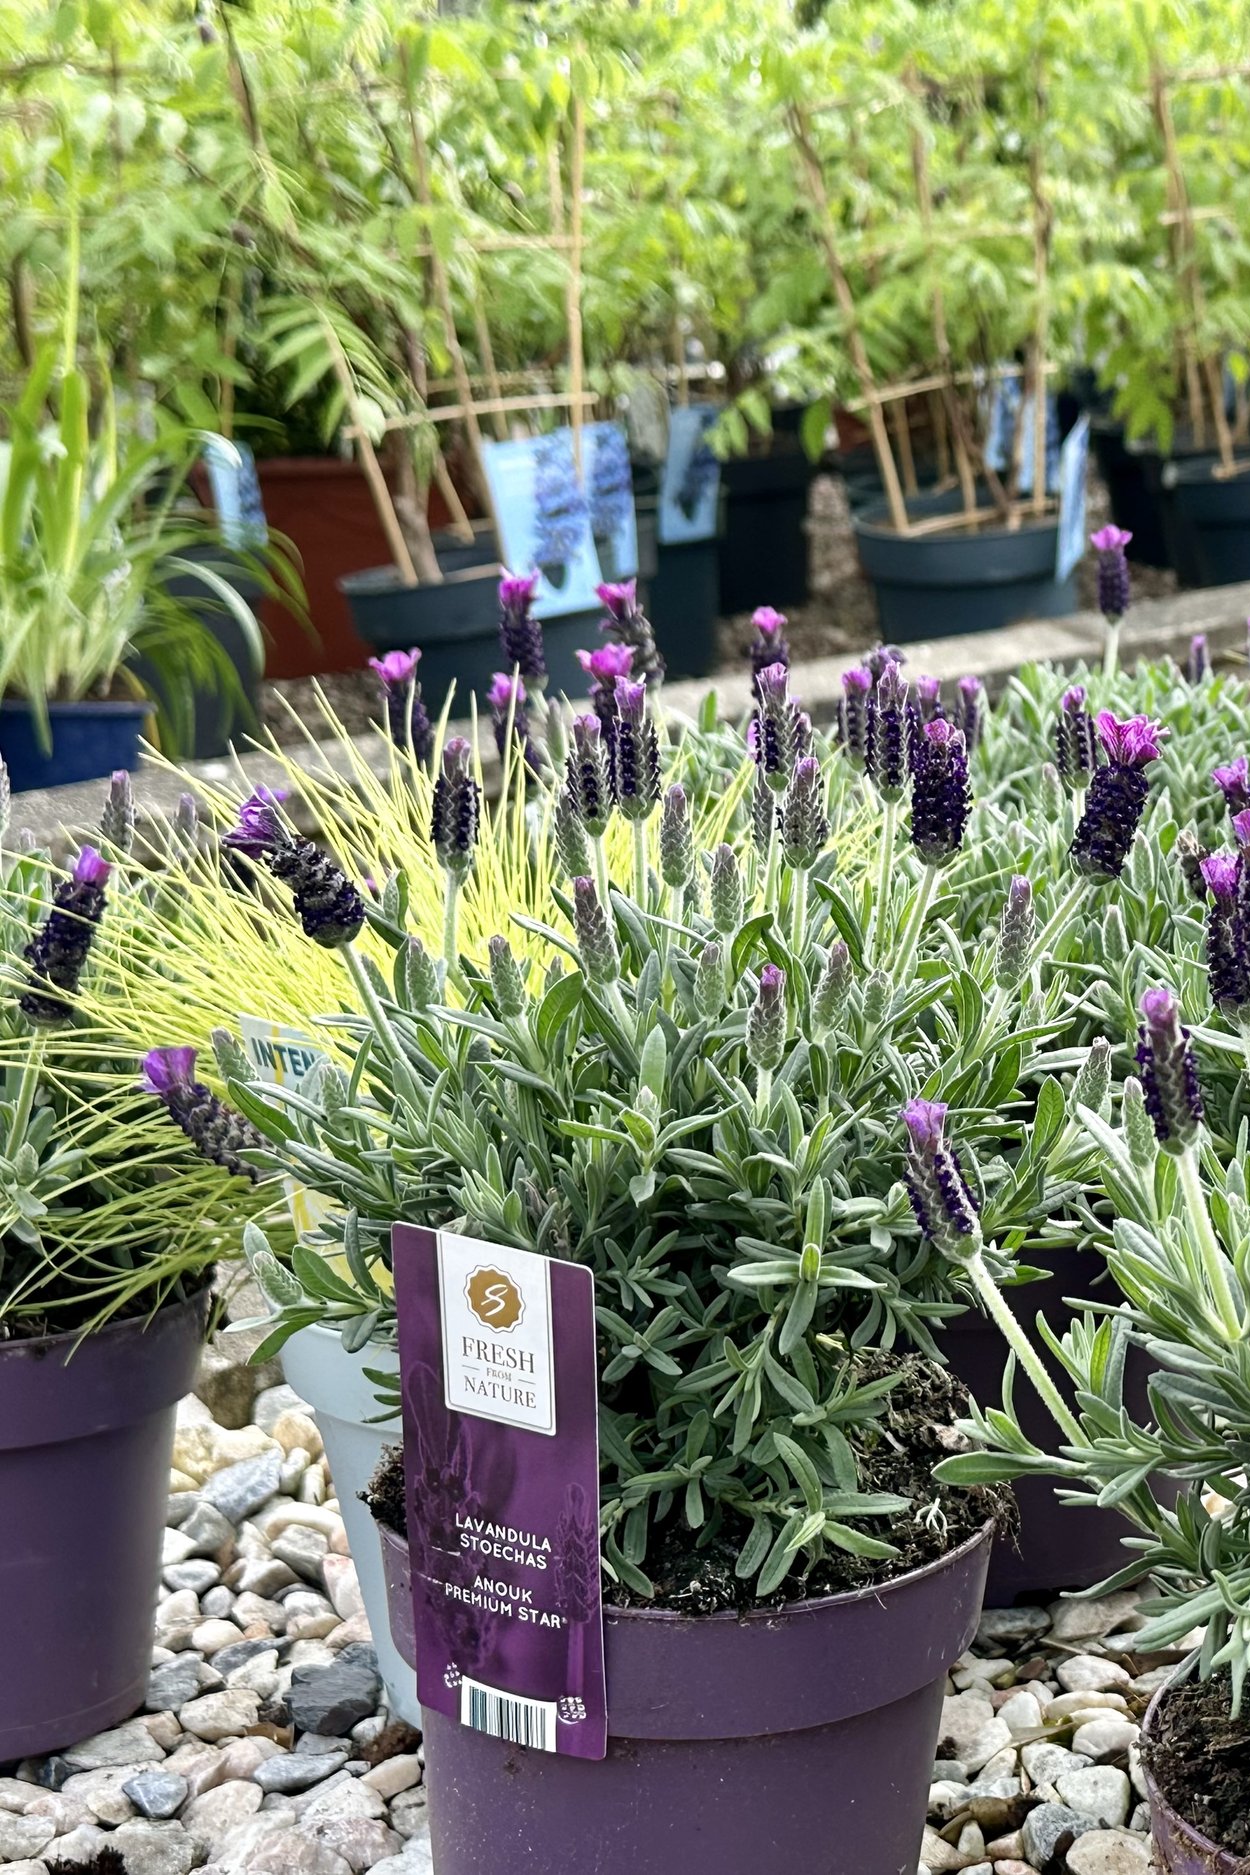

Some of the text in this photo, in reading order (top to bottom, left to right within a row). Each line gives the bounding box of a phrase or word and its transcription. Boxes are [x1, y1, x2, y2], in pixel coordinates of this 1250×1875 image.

[461, 1336, 536, 1374] FRESH
[463, 1375, 537, 1409] NATURE
[486, 1367, 512, 1382] FROM
[455, 1513, 551, 1552] LAVANDULA
[460, 1533, 547, 1570] STOECHAS
[445, 1582, 512, 1617] PREMIUM
[473, 1575, 533, 1604] ANOUK
